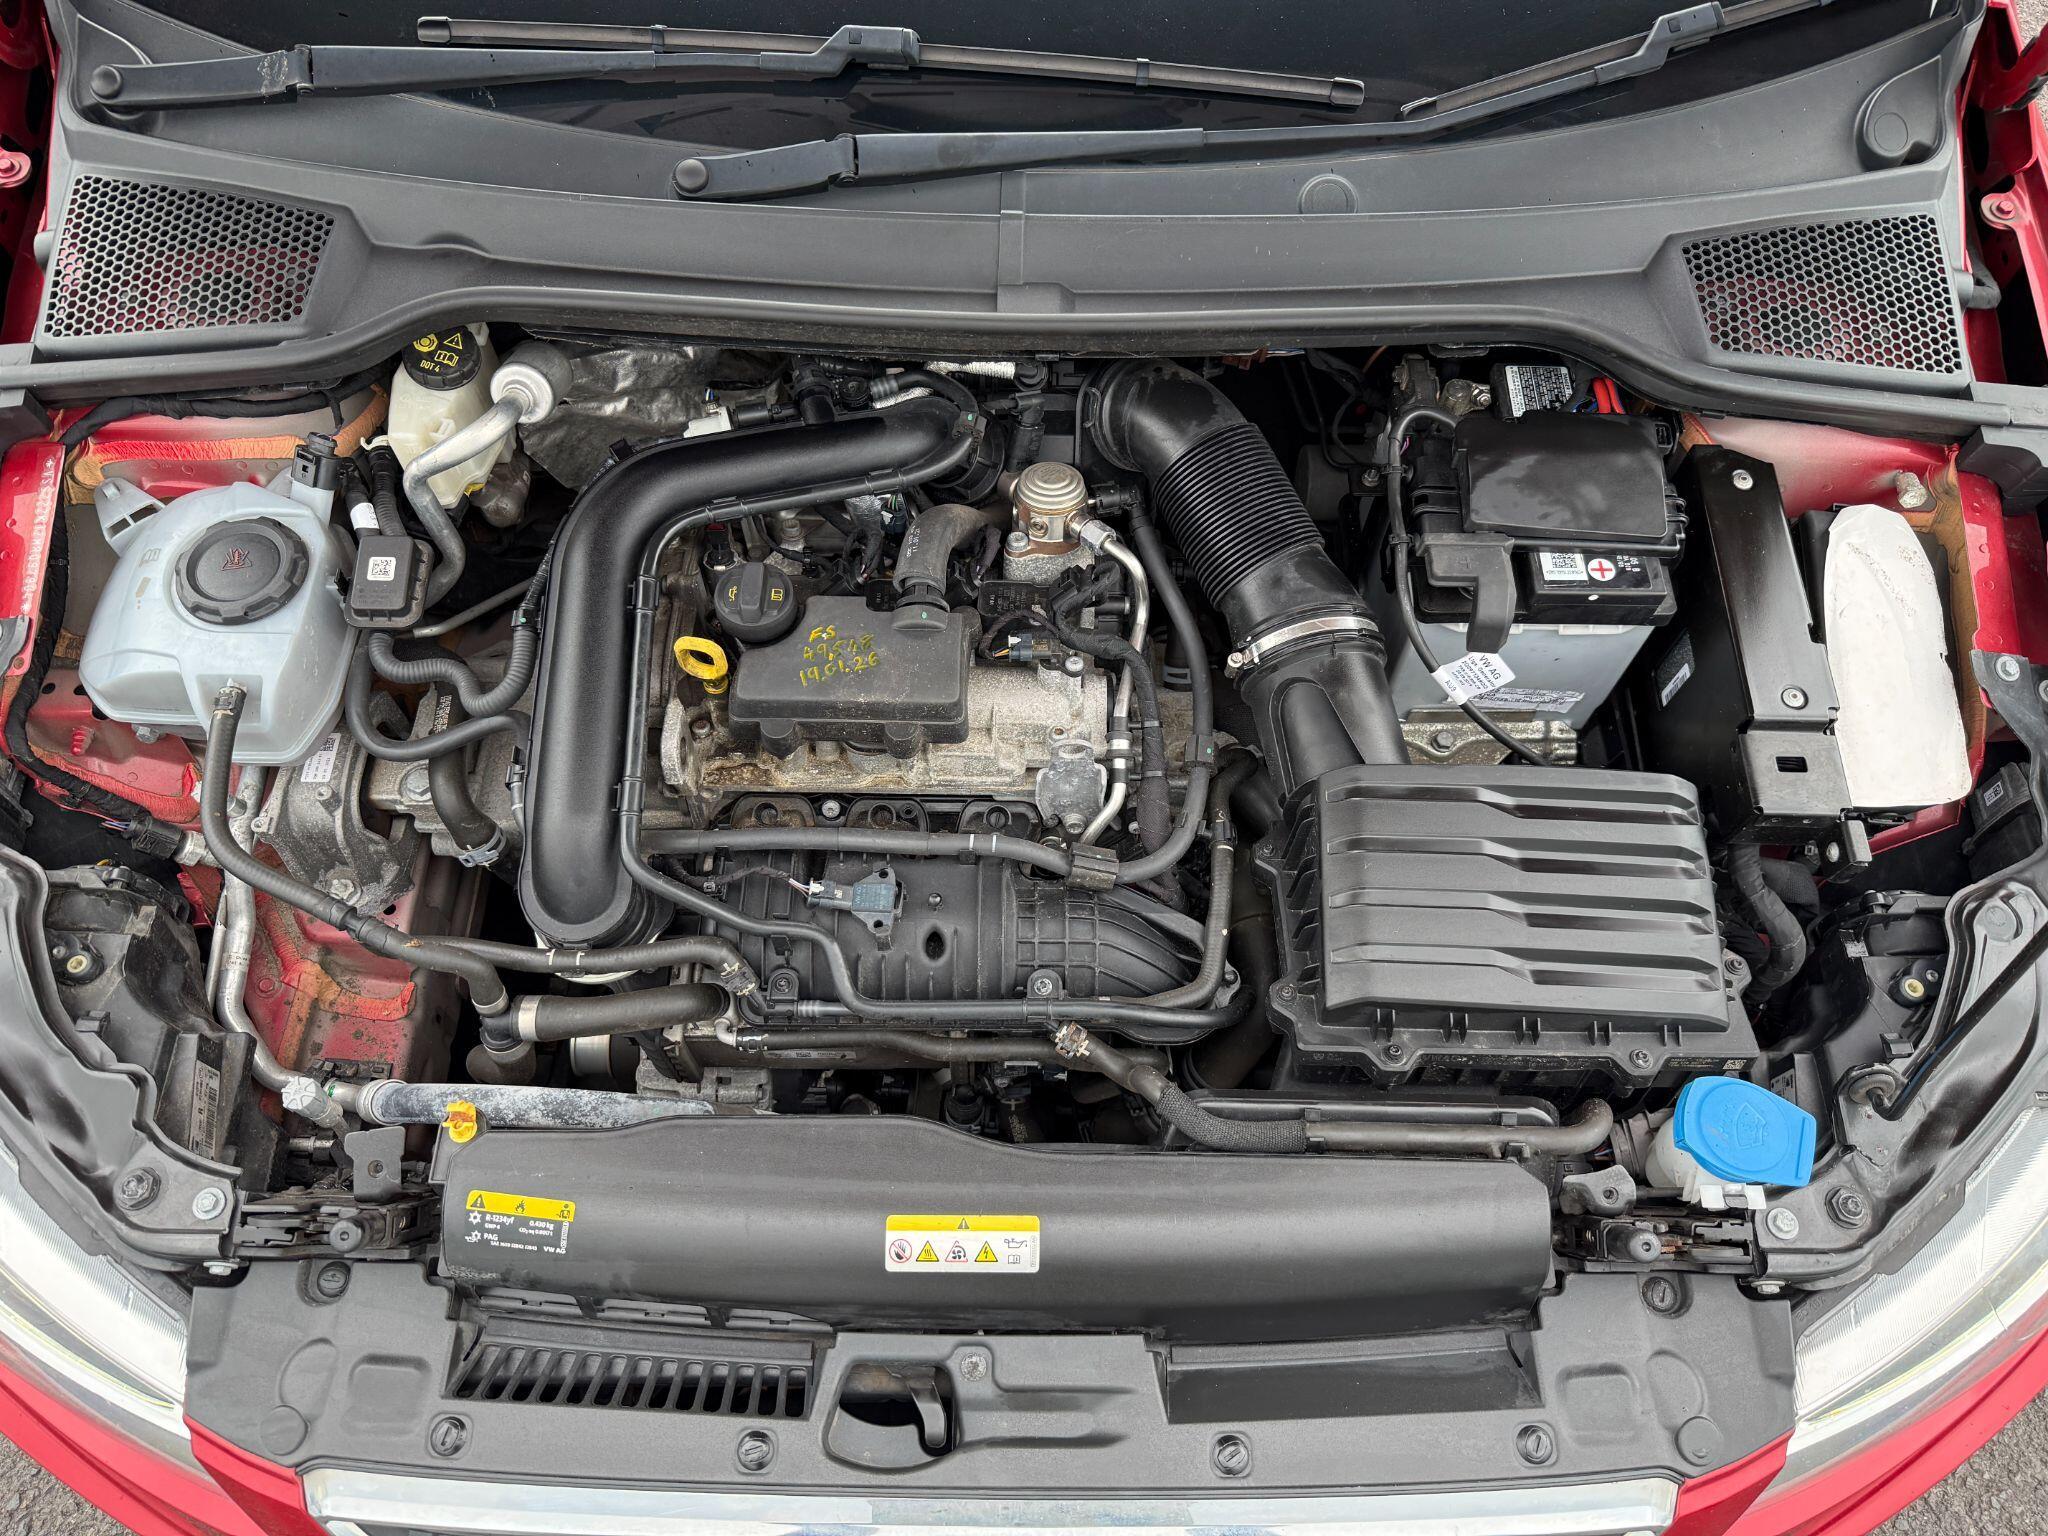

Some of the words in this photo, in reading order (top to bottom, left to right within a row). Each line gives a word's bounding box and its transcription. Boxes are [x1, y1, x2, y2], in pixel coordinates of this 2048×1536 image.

[420, 360, 434, 371] DOT
[434, 365, 441, 373] 4
[1480, 654, 1493, 668] VW
[1489, 668, 1501, 680] AG
[486, 1214, 514, 1225] R-1234yf
[546, 1222, 554, 1231] kg
[483, 1232, 499, 1241] PAG
[555, 1246, 567, 1254] AG
